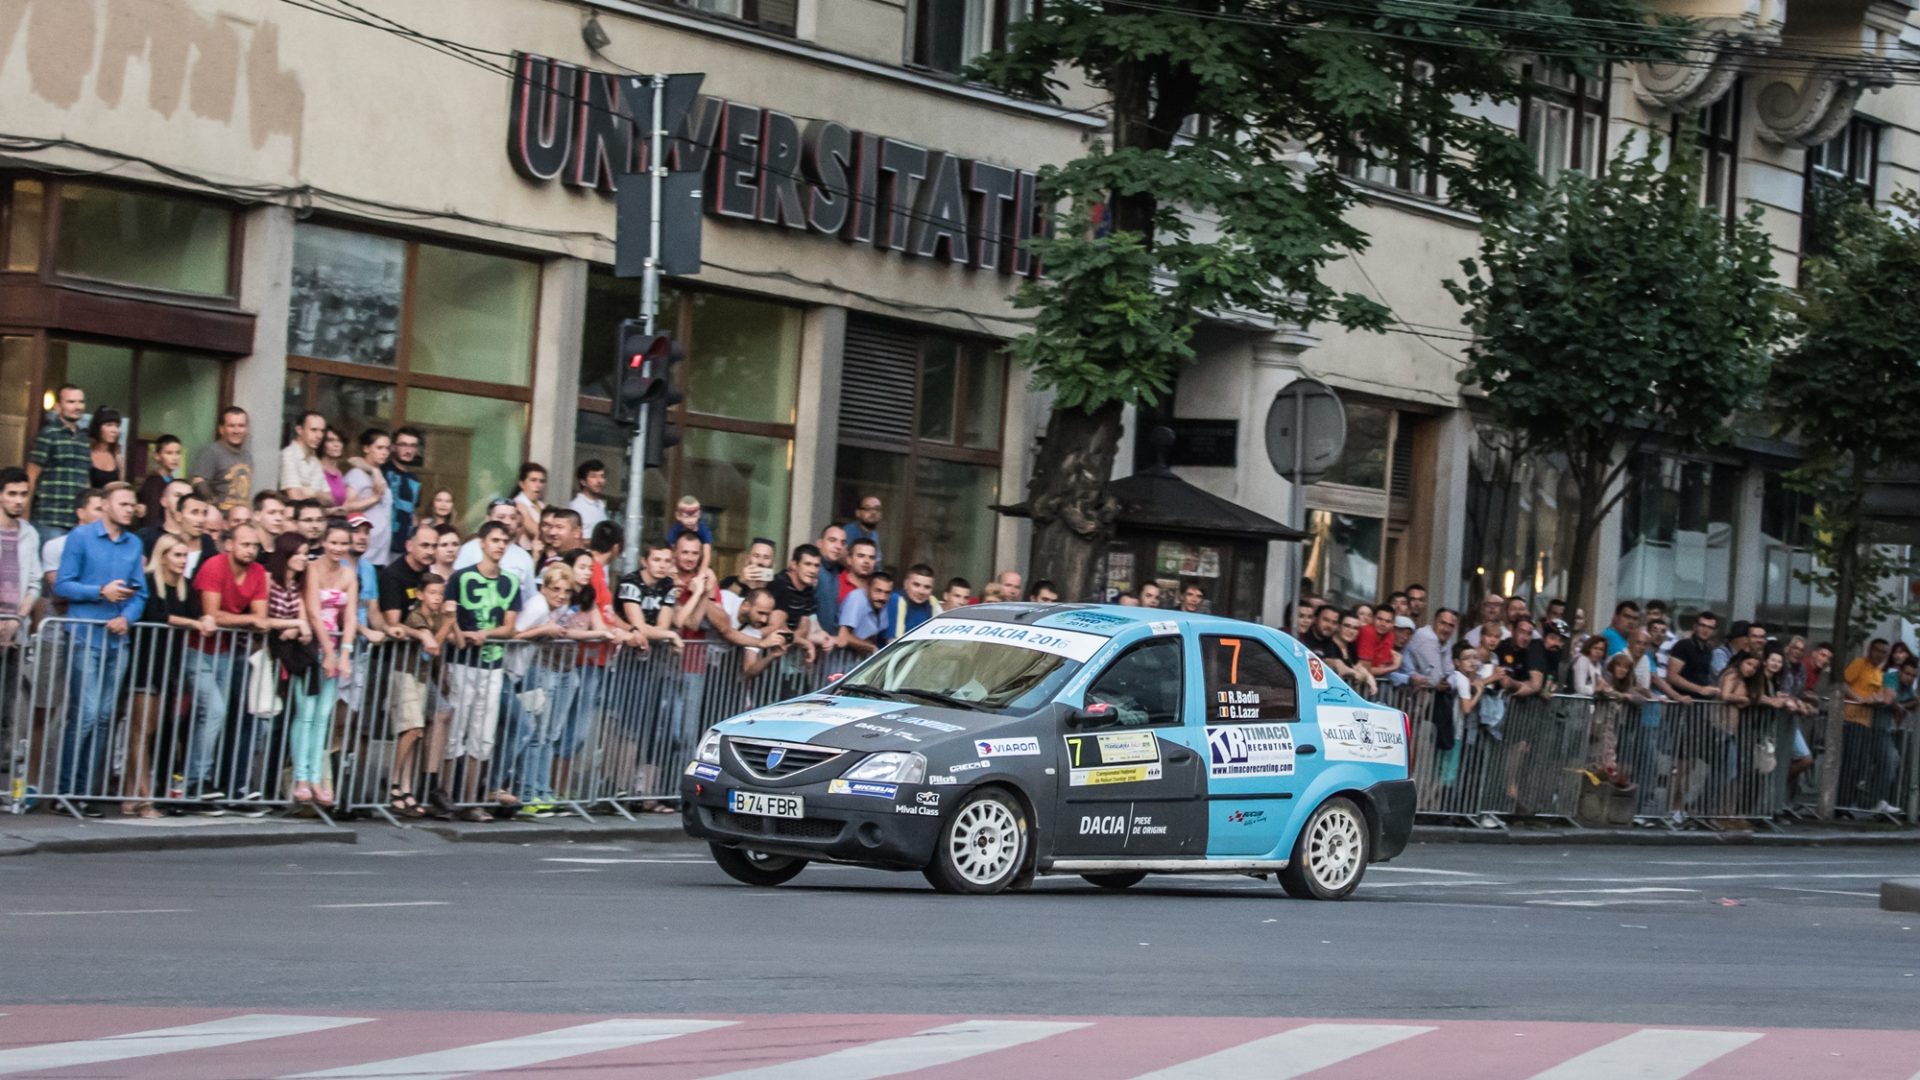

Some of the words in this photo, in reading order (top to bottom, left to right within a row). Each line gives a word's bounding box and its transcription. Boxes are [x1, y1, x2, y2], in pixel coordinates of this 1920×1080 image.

[930, 625, 972, 636] CUPA
[974, 626, 1030, 642] DACIA
[1219, 638, 1241, 685] 7
[1228, 691, 1260, 704] R.Badiu
[1229, 705, 1260, 719] G.Lazar
[1243, 726, 1290, 741] TIMACO
[993, 742, 1038, 753] VIAROM
[1068, 738, 1082, 767] 7
[1247, 742, 1293, 752] RECRUTING
[1212, 763, 1293, 775] www.timacorecruting.com
[852, 784, 896, 794] MICHELIN
[736, 794, 745, 810] B
[748, 795, 763, 814] 74
[767, 797, 798, 817] FBR
[895, 804, 916, 815] Mival
[917, 806, 939, 817] Class
[1079, 815, 1125, 835] DACIA
[1134, 816, 1152, 826] PIESE
[1132, 826, 1141, 835] DE
[1142, 826, 1168, 836] ORIGINE
